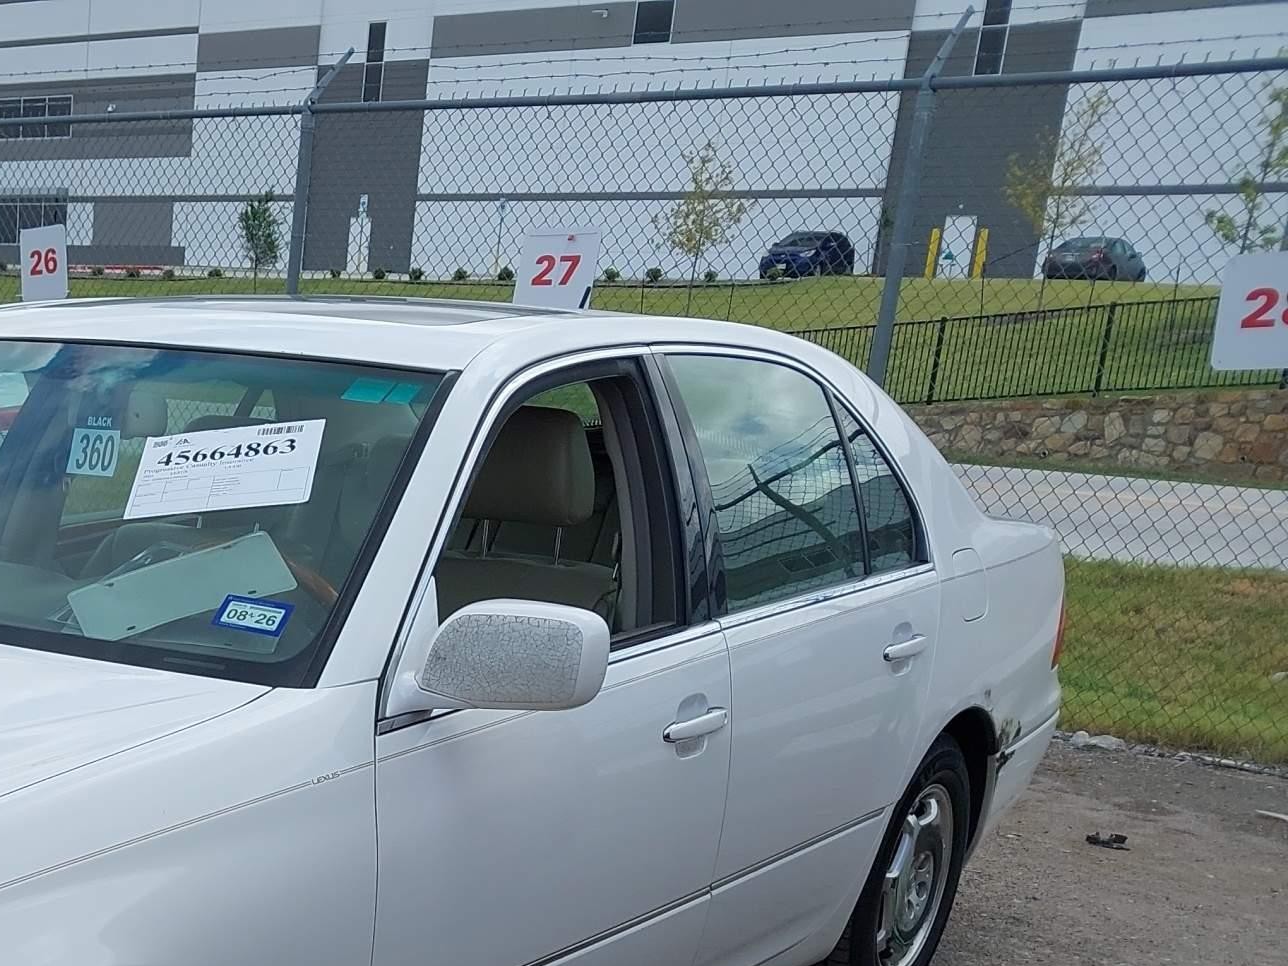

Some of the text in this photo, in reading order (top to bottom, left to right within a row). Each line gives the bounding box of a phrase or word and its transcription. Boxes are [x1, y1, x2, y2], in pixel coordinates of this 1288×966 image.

[30, 248, 57, 276] 26
[531, 255, 581, 286] 27
[1240, 287, 1288, 328] 2
[88, 416, 112, 427] BLACK
[76, 434, 114, 471] 360
[157, 438, 297, 467] 45664863
[226, 608, 249, 621] 08
[254, 613, 278, 626] 26
[312, 771, 340, 784] LEXUS
